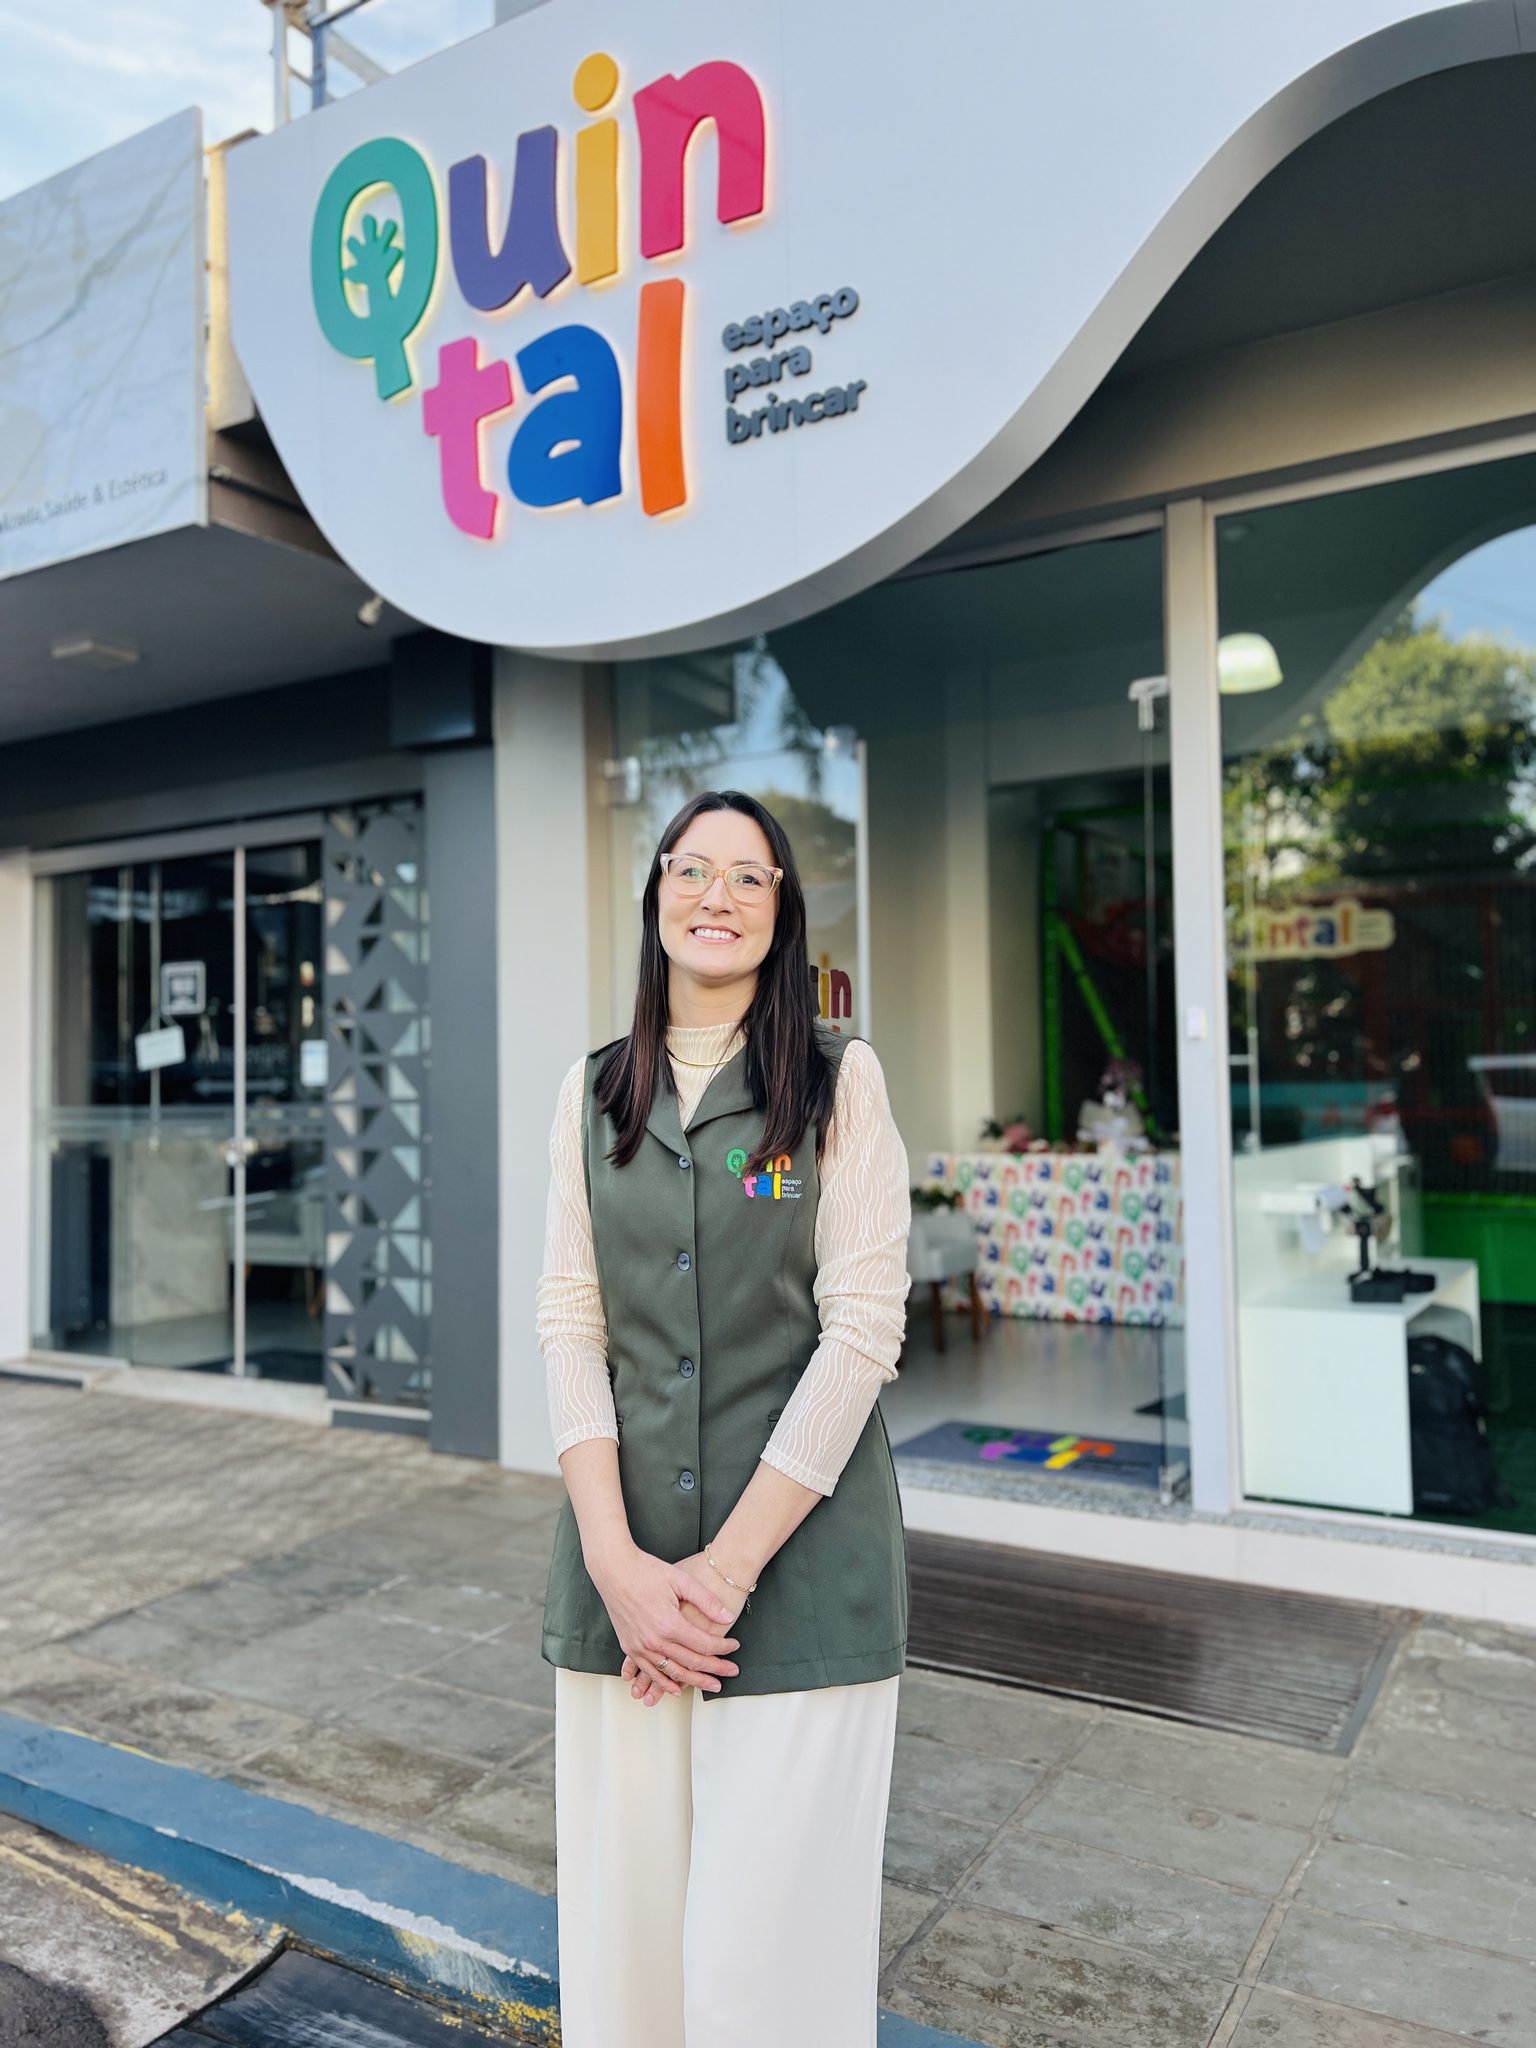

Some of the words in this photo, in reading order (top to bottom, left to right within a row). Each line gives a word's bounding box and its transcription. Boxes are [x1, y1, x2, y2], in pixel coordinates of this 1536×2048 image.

[311, 53, 765, 401] Quin
[722, 286, 859, 352] espaço
[725, 346, 812, 404] para
[422, 278, 687, 540] tal
[726, 379, 867, 445] brincar
[743, 1172, 782, 1200] tal
